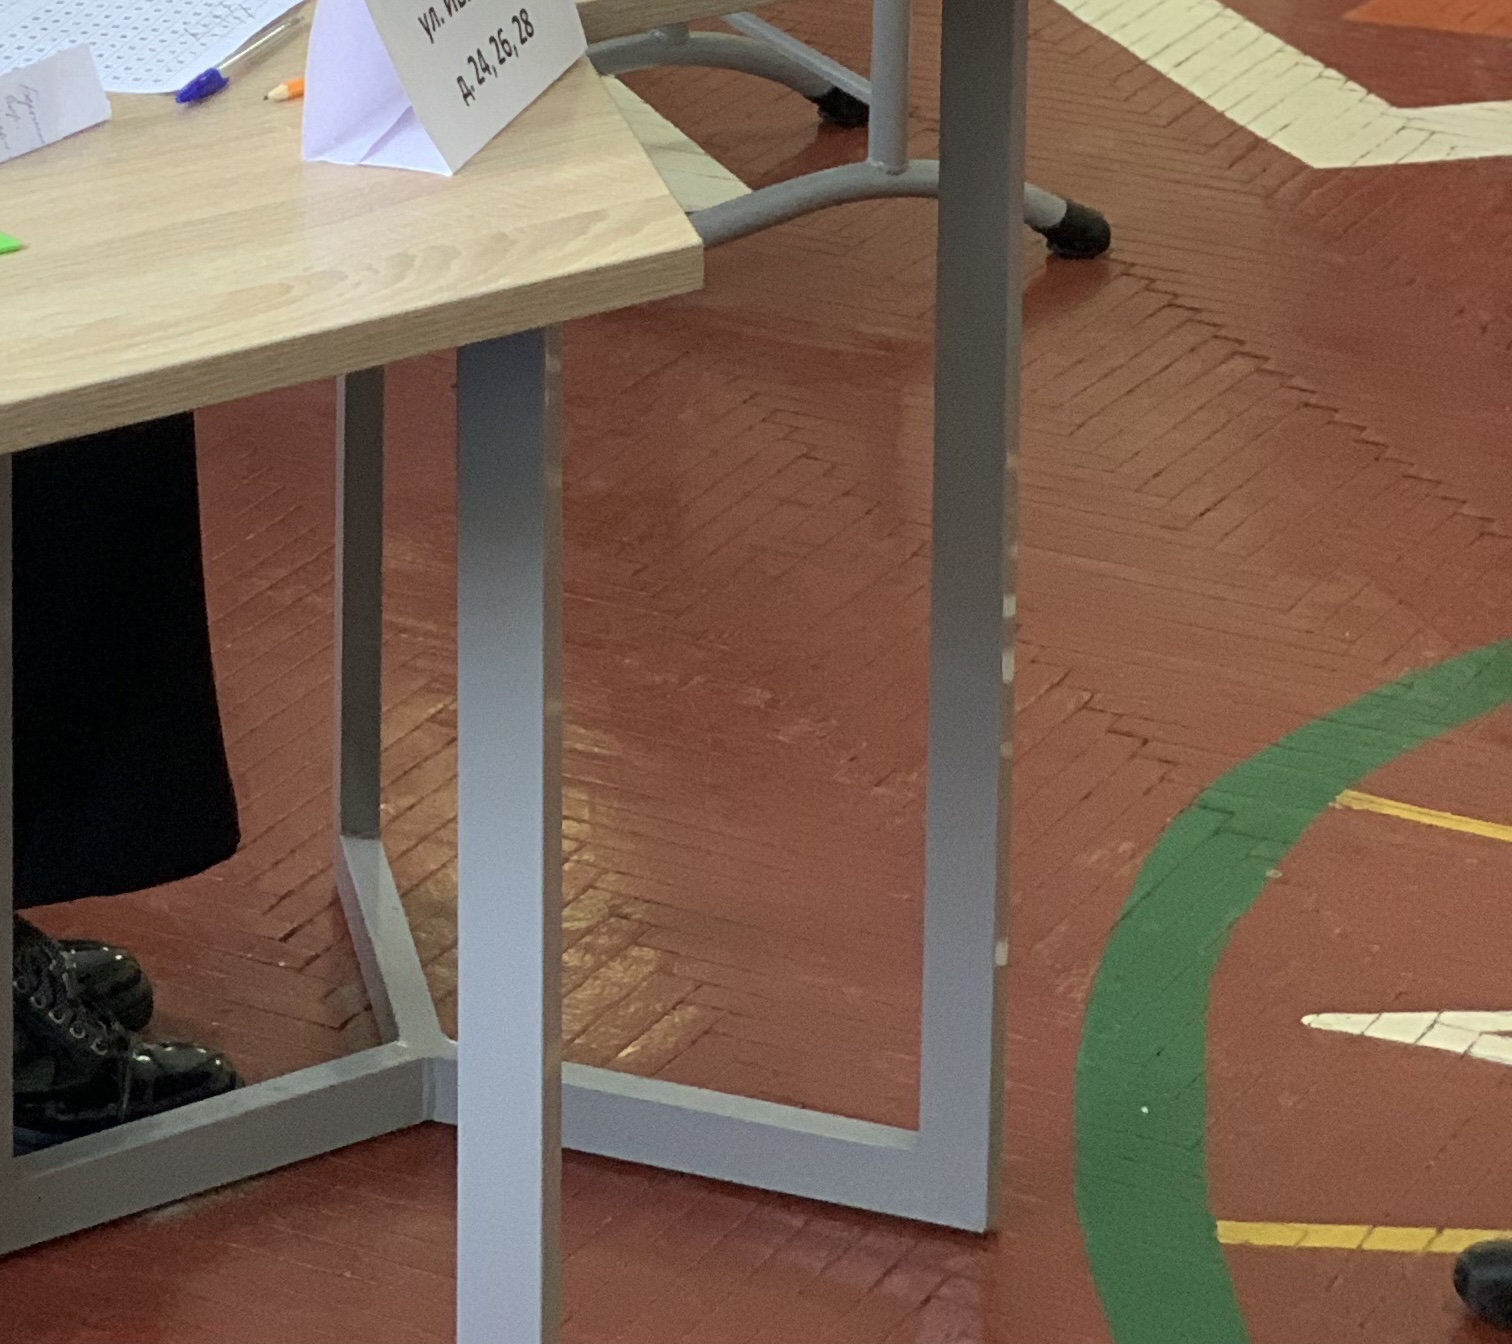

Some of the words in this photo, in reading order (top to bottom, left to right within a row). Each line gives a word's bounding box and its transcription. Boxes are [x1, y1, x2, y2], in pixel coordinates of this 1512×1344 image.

[417, 6, 445, 45] ул.
[456, 75, 476, 107] д.
[467, 47, 499, 86] 24,
[488, 27, 519, 66] 26,
[511, 7, 535, 46] 28
